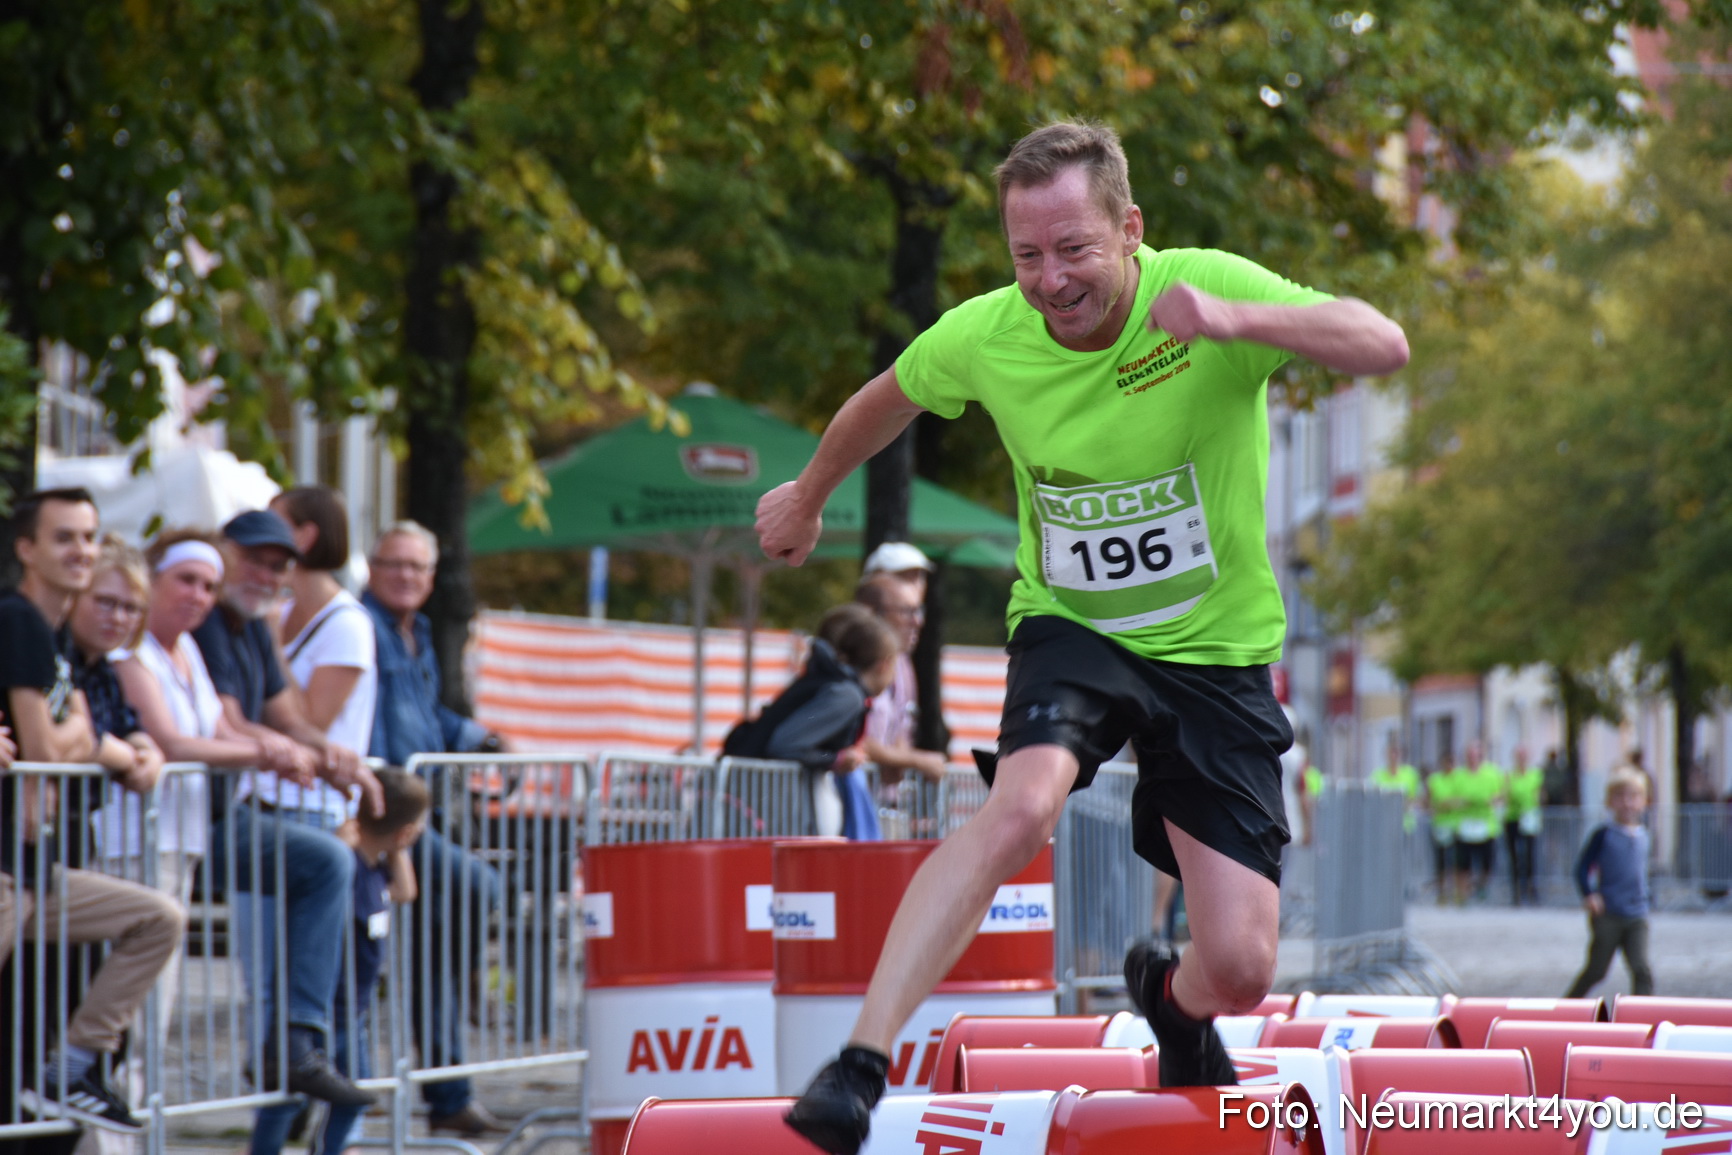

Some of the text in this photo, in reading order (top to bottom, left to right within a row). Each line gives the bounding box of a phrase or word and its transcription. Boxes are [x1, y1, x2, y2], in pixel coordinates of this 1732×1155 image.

[1133, 370, 1174, 393] September
[1038, 475, 1186, 527] BOCK
[1070, 528, 1173, 582] 196
